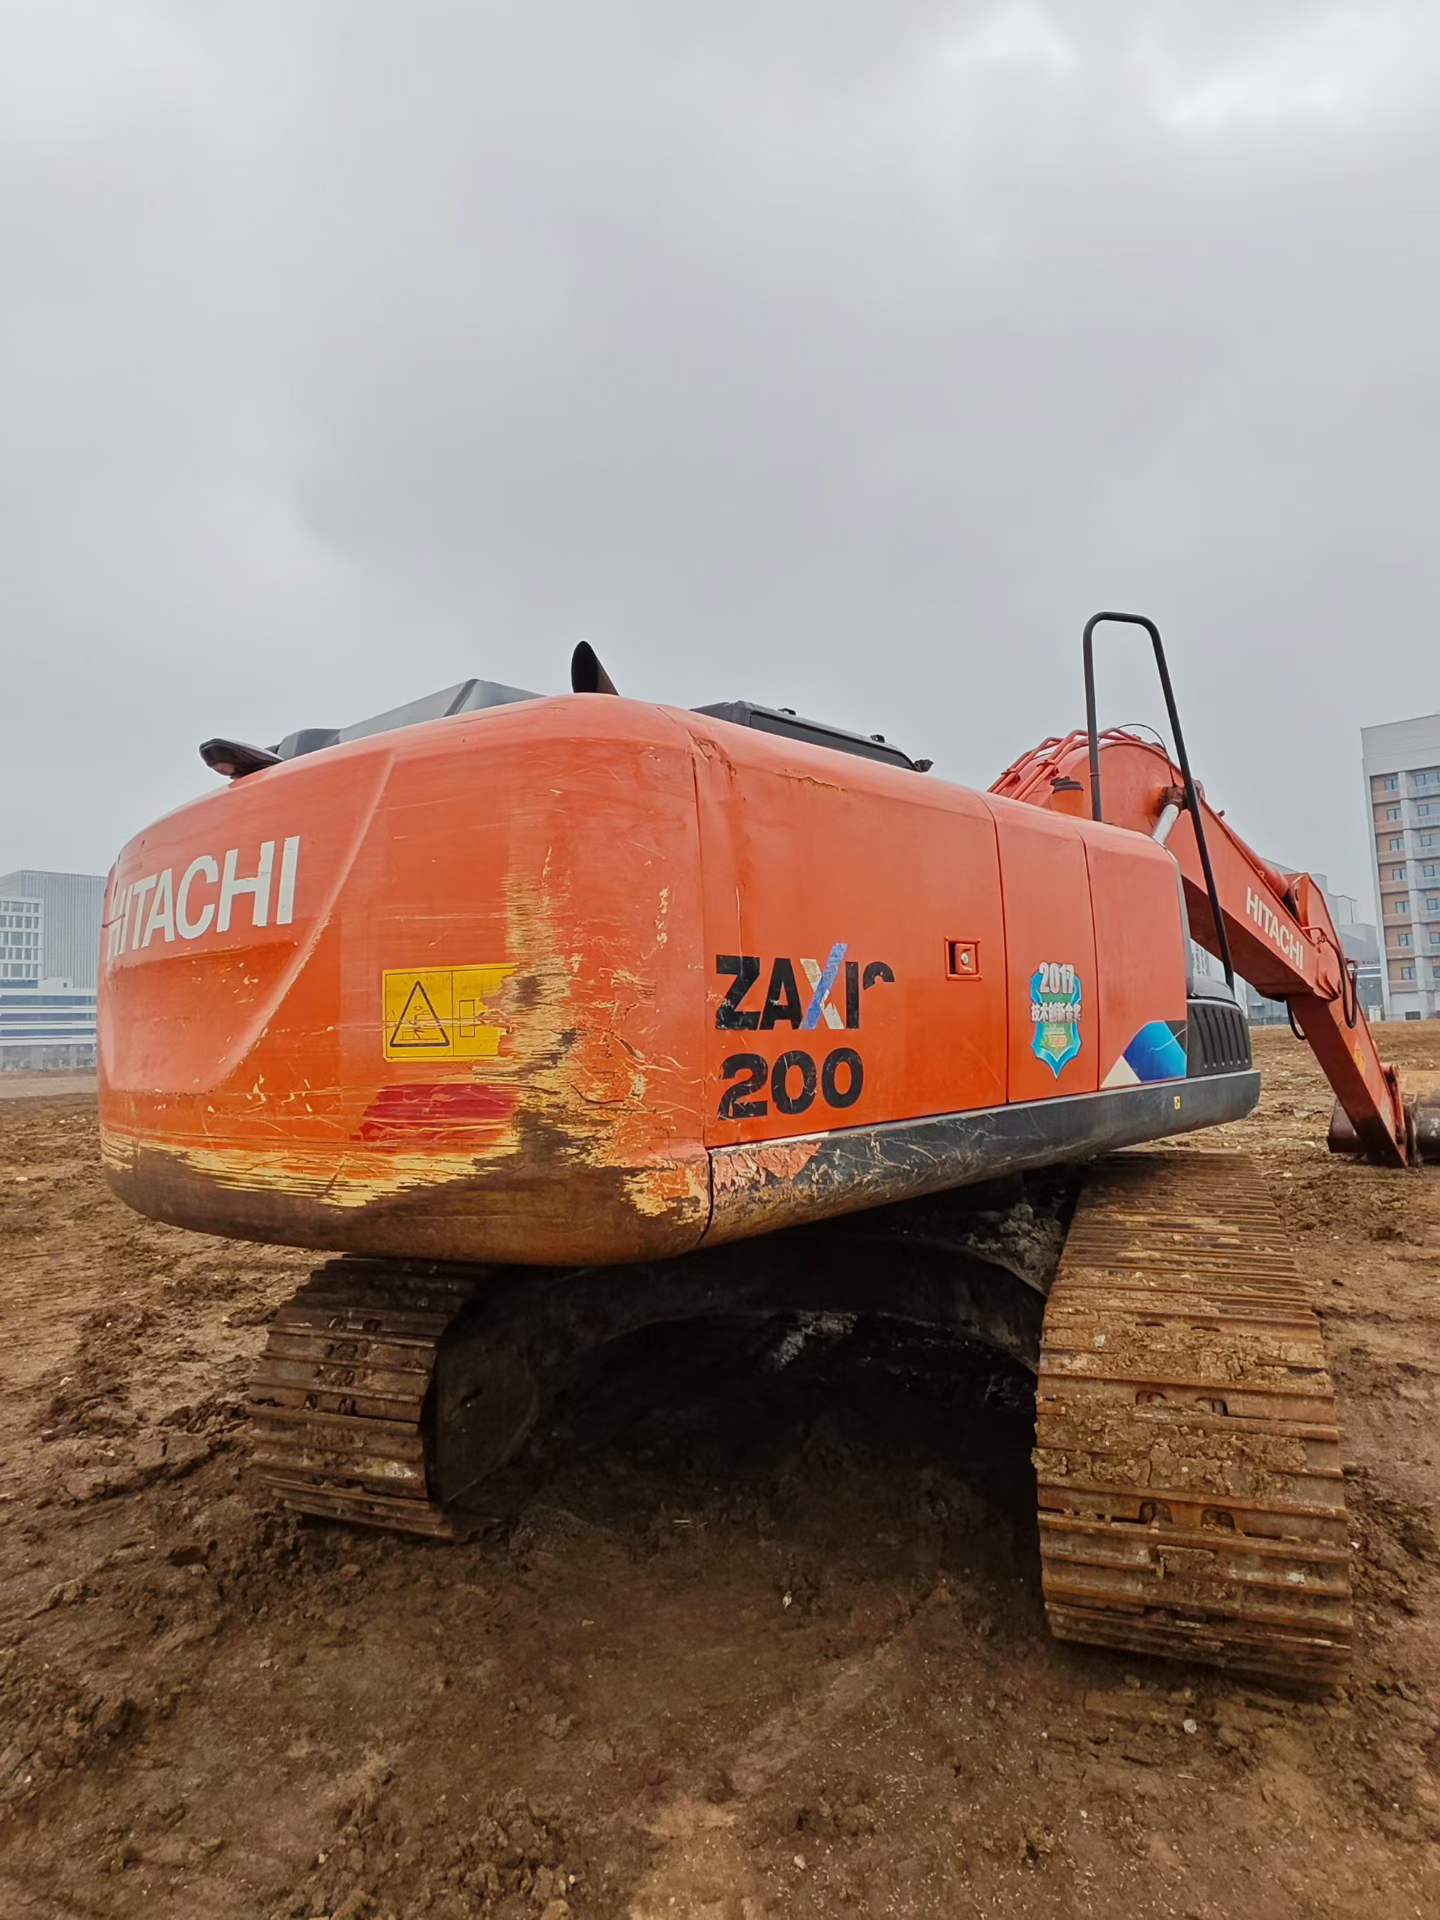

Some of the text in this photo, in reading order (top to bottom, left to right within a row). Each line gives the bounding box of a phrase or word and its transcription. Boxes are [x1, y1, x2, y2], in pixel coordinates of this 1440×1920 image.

[106, 835, 300, 972] HITACHI
[1246, 886, 1304, 970] HITACHI
[1039, 962, 1075, 994] 2017
[718, 1047, 864, 1120] 200
